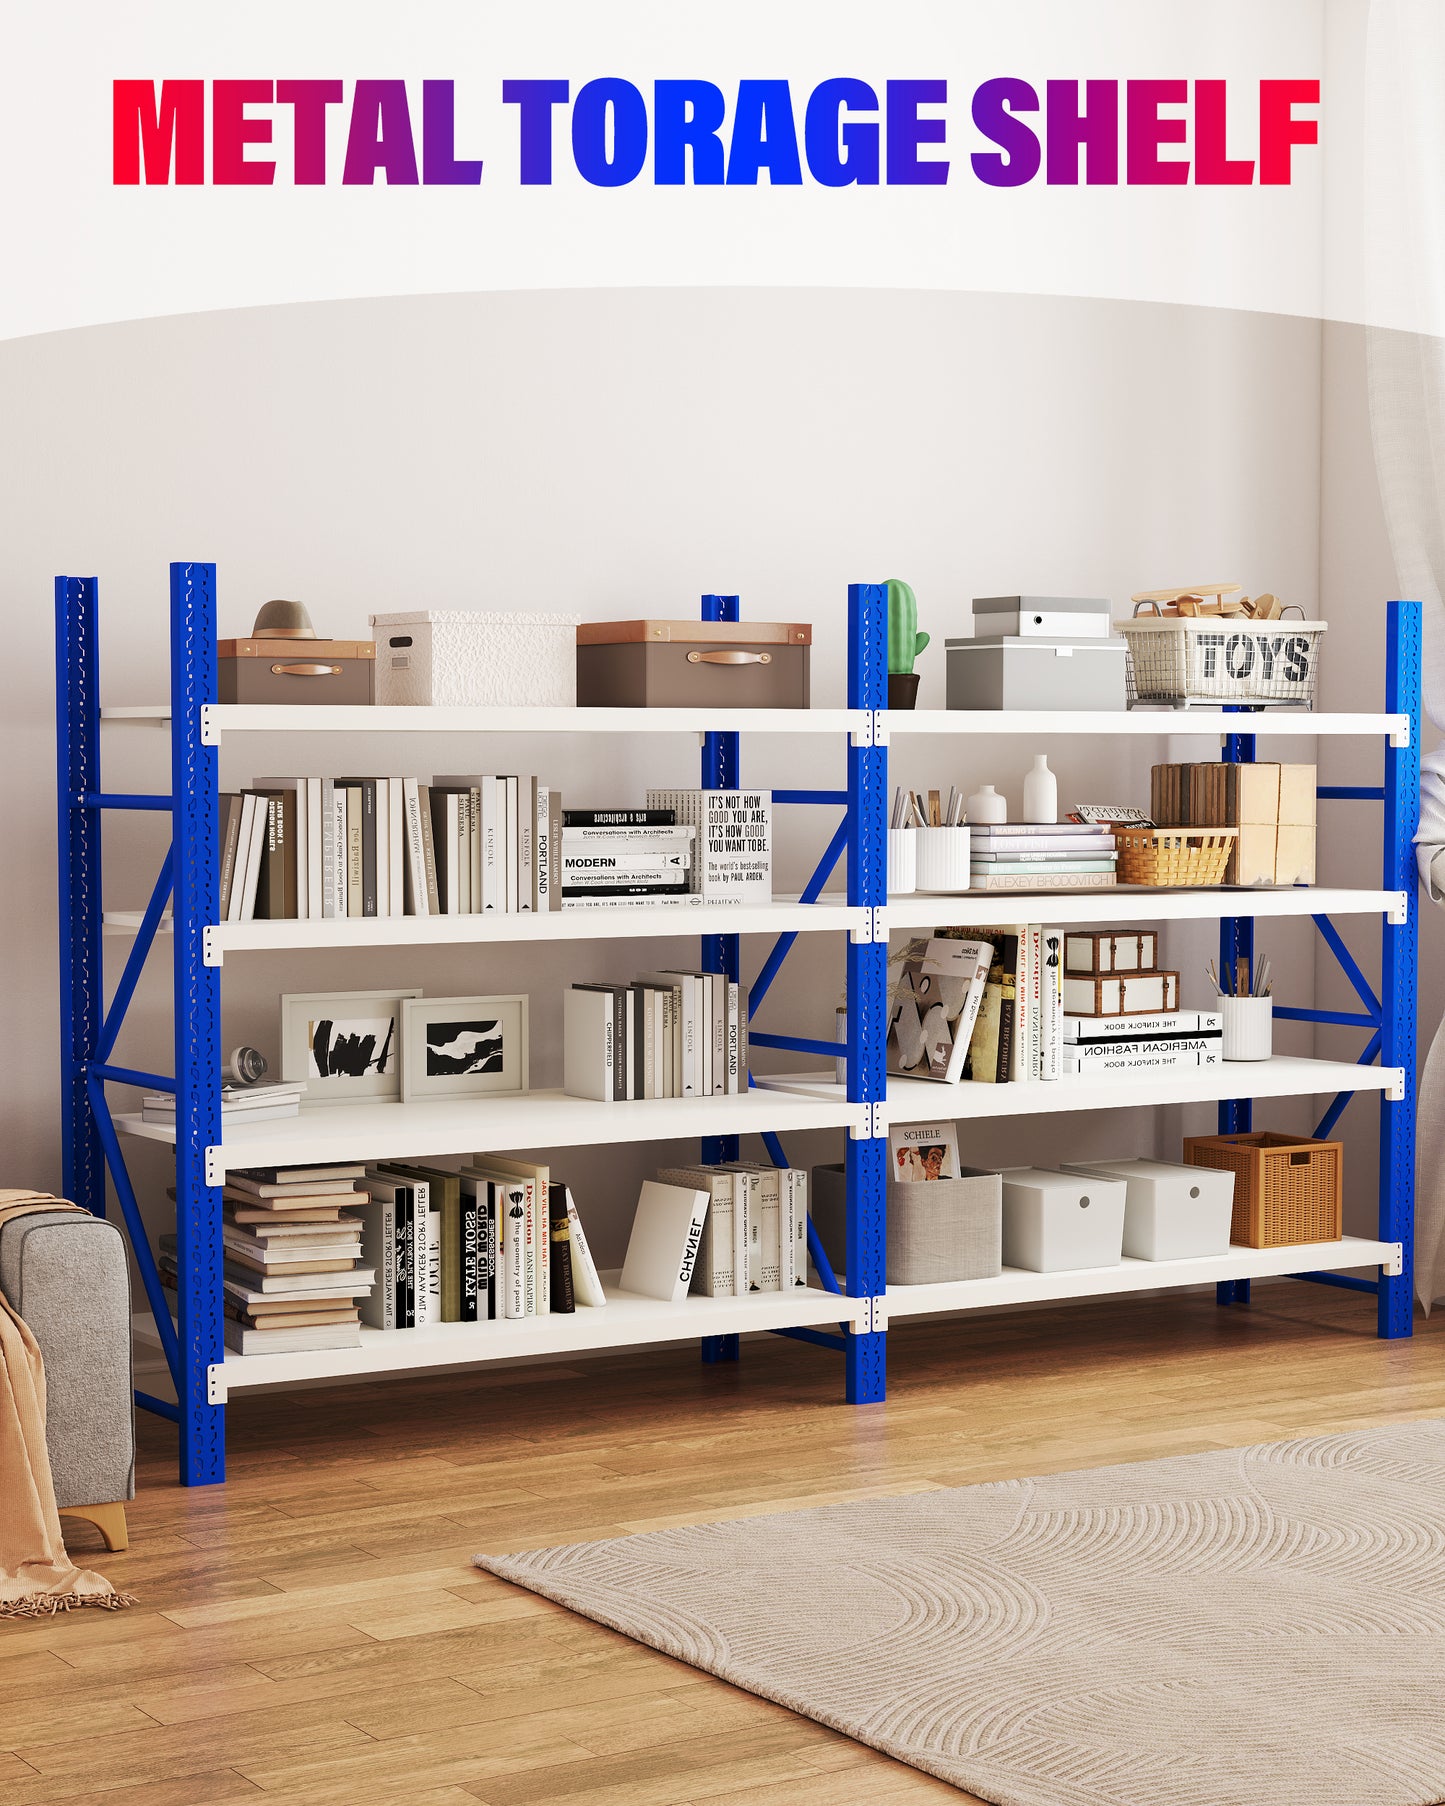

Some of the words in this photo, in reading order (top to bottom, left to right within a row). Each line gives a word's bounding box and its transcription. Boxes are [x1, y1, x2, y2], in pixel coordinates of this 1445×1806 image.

[1196, 634, 1310, 682] TOYS
[708, 796, 723, 809] IT'S
[725, 796, 740, 809] NOT
[743, 796, 761, 809] HOW
[594, 813, 628, 824] architecture
[636, 813, 647, 822] arts
[708, 810, 729, 824] GOOD
[732, 810, 748, 823] YOU
[750, 810, 768, 825] ARE,
[708, 825, 723, 838] IT'S
[725, 825, 742, 838] HOW
[744, 824, 764, 838] GOOD
[708, 839, 724, 853] YOU
[724, 839, 746, 852] WANT
[538, 835, 548, 894] PORTLAND
[564, 858, 616, 869] MODERN
[670, 856, 680, 865] A
[708, 862, 718, 871] The
[720, 862, 738, 871] world's
[740, 861, 769, 872] best-selling
[708, 874, 721, 882] book
[722, 873, 729, 884] by
[730, 872, 744, 882] PAUL
[745, 872, 765, 881] ARDEN.
[990, 876, 1033, 888] ALEXEY
[1037, 874, 1109, 887] BRODOVITCH
[904, 1129, 941, 1141] SCHIELE
[541, 1218, 547, 1229] HA
[575, 1233, 583, 1241] Art
[560, 1244, 569, 1264] RAY
[515, 1279, 521, 1288] of
[562, 1264, 573, 1312] BRADBURY
